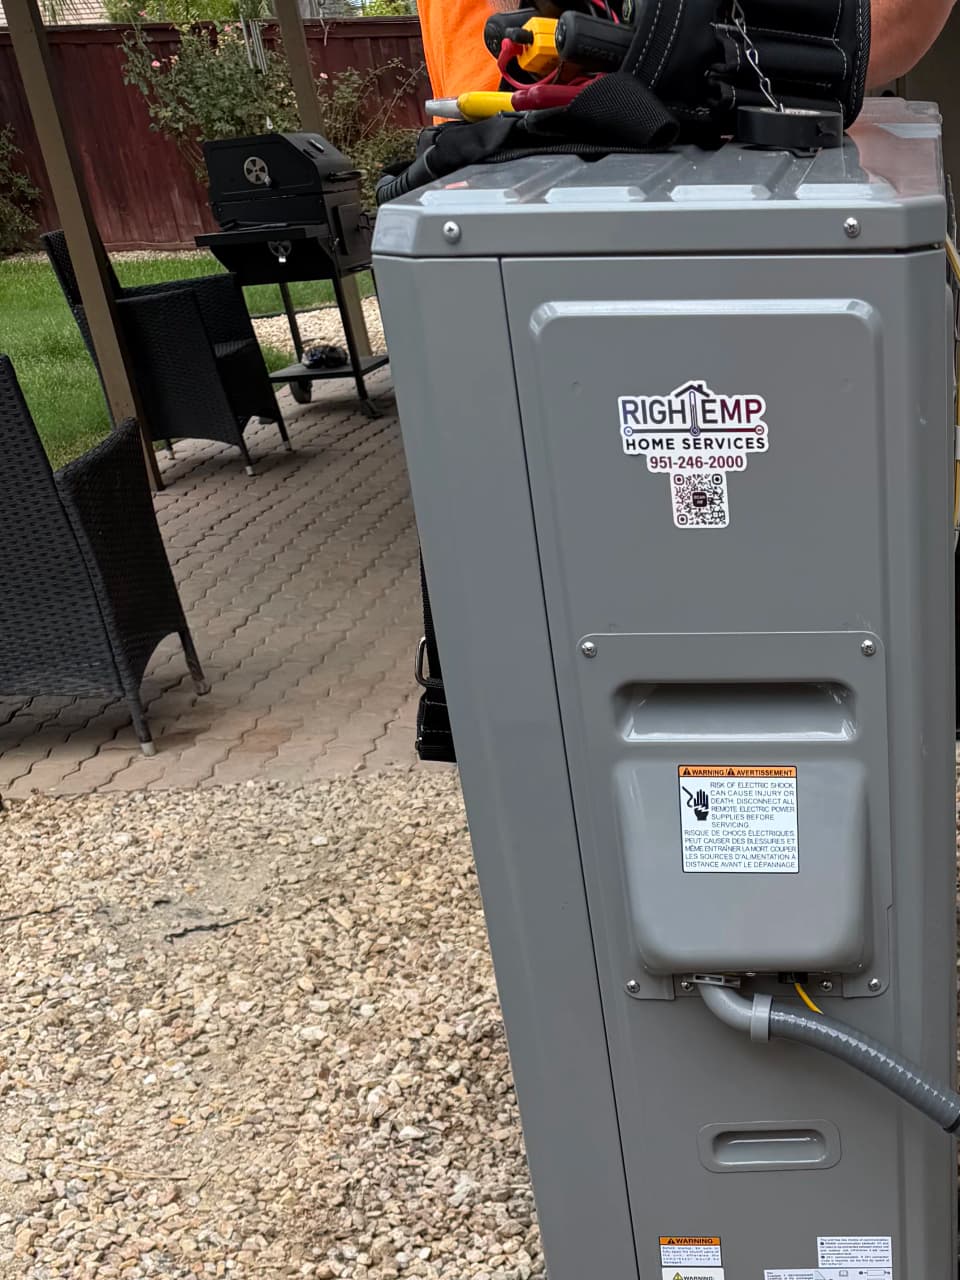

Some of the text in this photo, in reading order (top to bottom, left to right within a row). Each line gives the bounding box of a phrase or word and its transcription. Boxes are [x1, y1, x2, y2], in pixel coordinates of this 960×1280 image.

[626, 438, 766, 450] HOME SERVICES
[650, 456, 744, 469] 951-246-2000
